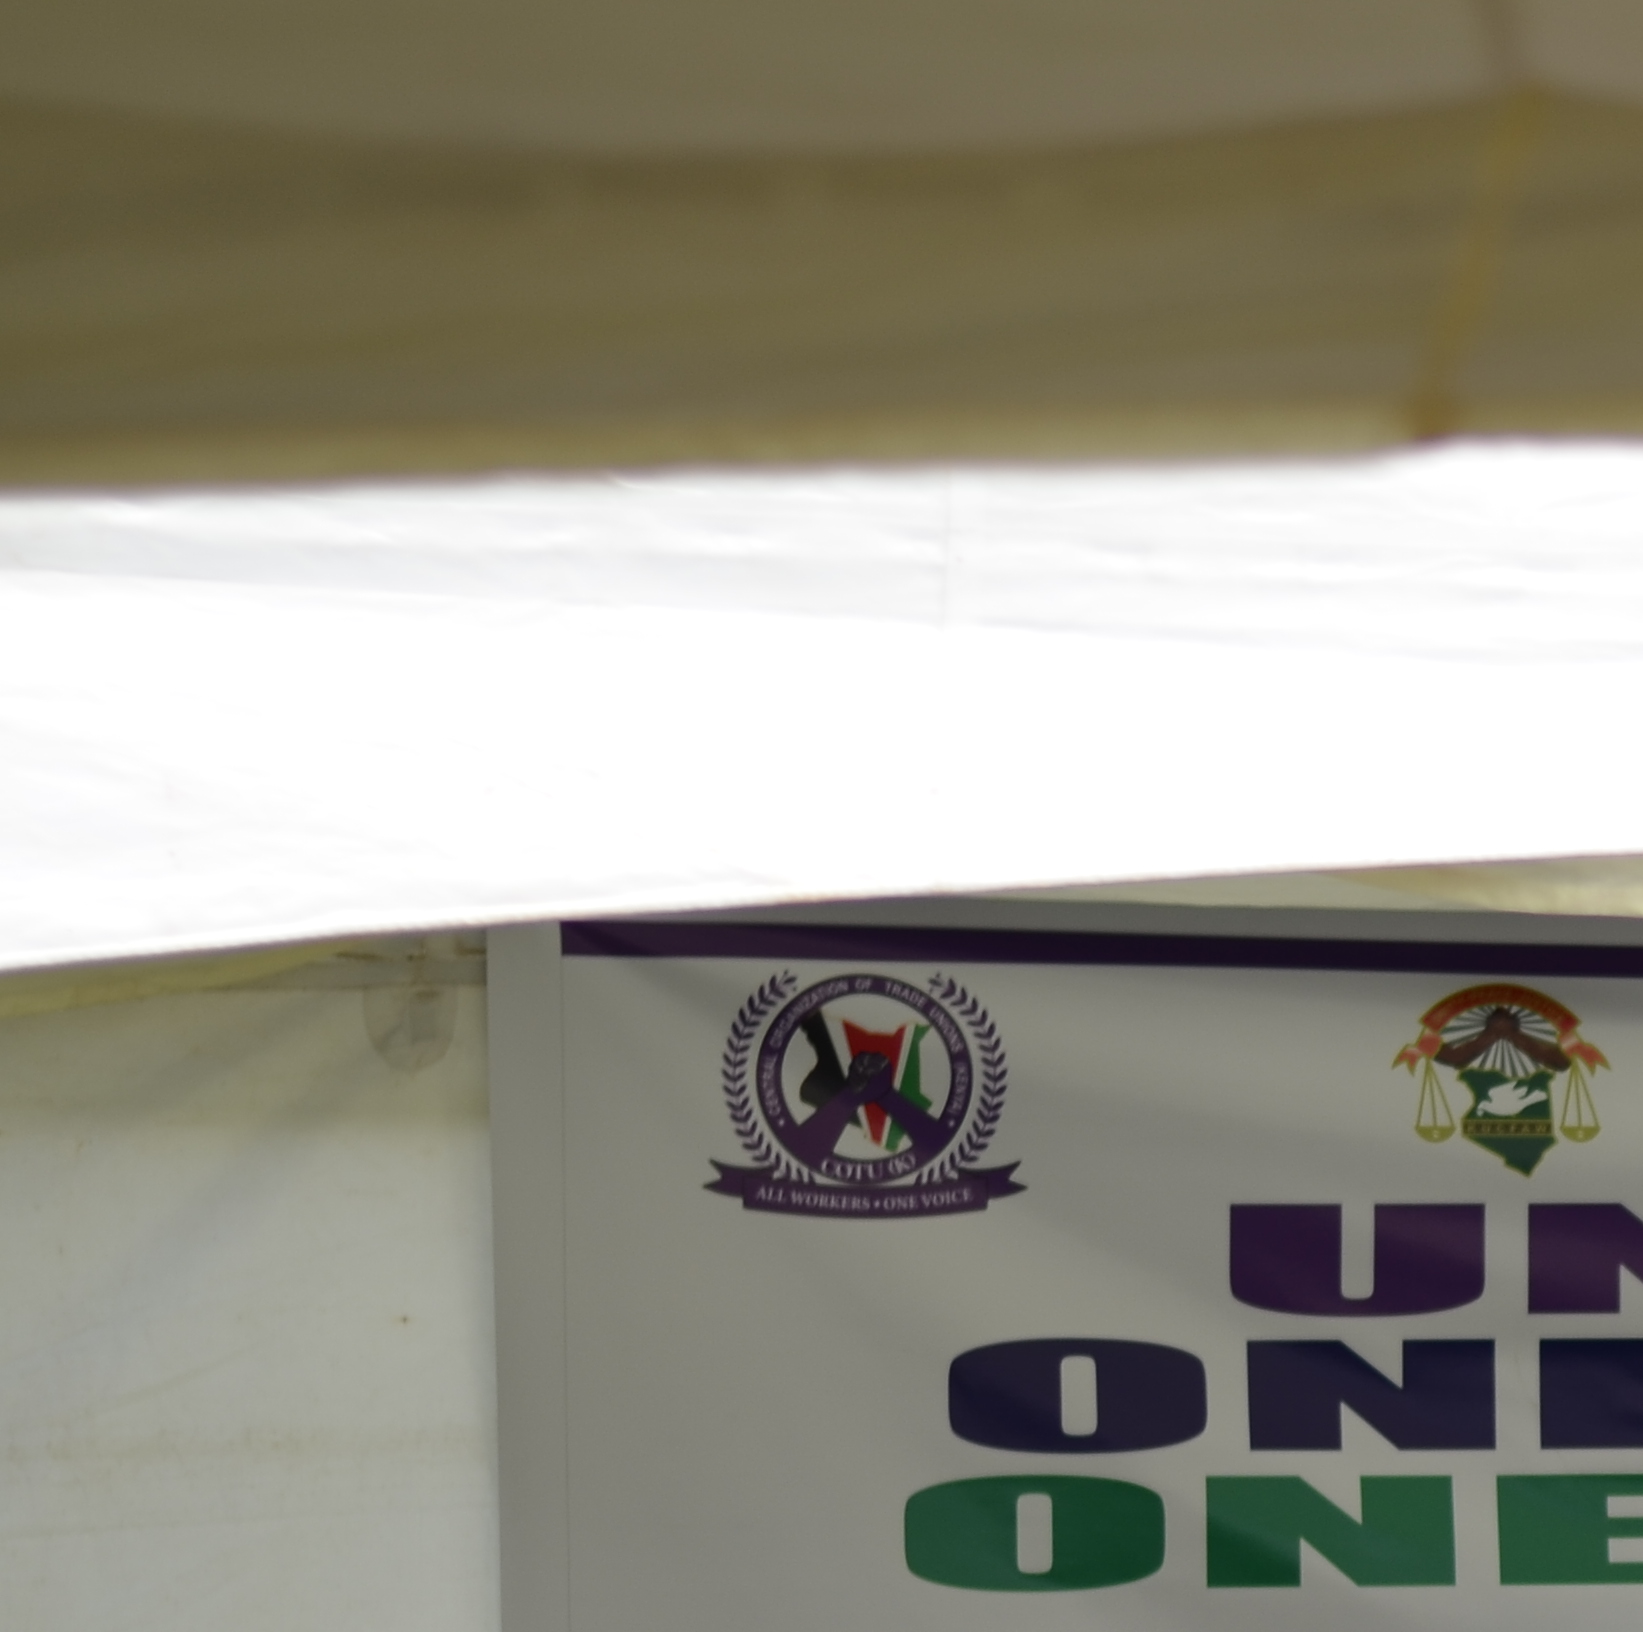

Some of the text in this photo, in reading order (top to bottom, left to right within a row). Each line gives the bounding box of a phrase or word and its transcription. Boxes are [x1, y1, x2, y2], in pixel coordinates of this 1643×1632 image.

[769, 980, 849, 1049] ORGANIZATION
[855, 979, 871, 990] OF
[885, 981, 925, 1008] TRADE
[929, 1006, 964, 1052] UNIONS
[821, 1158, 883, 1180] COTU
[756, 1185, 973, 1212] ALL WORKERS ONE VOICE
